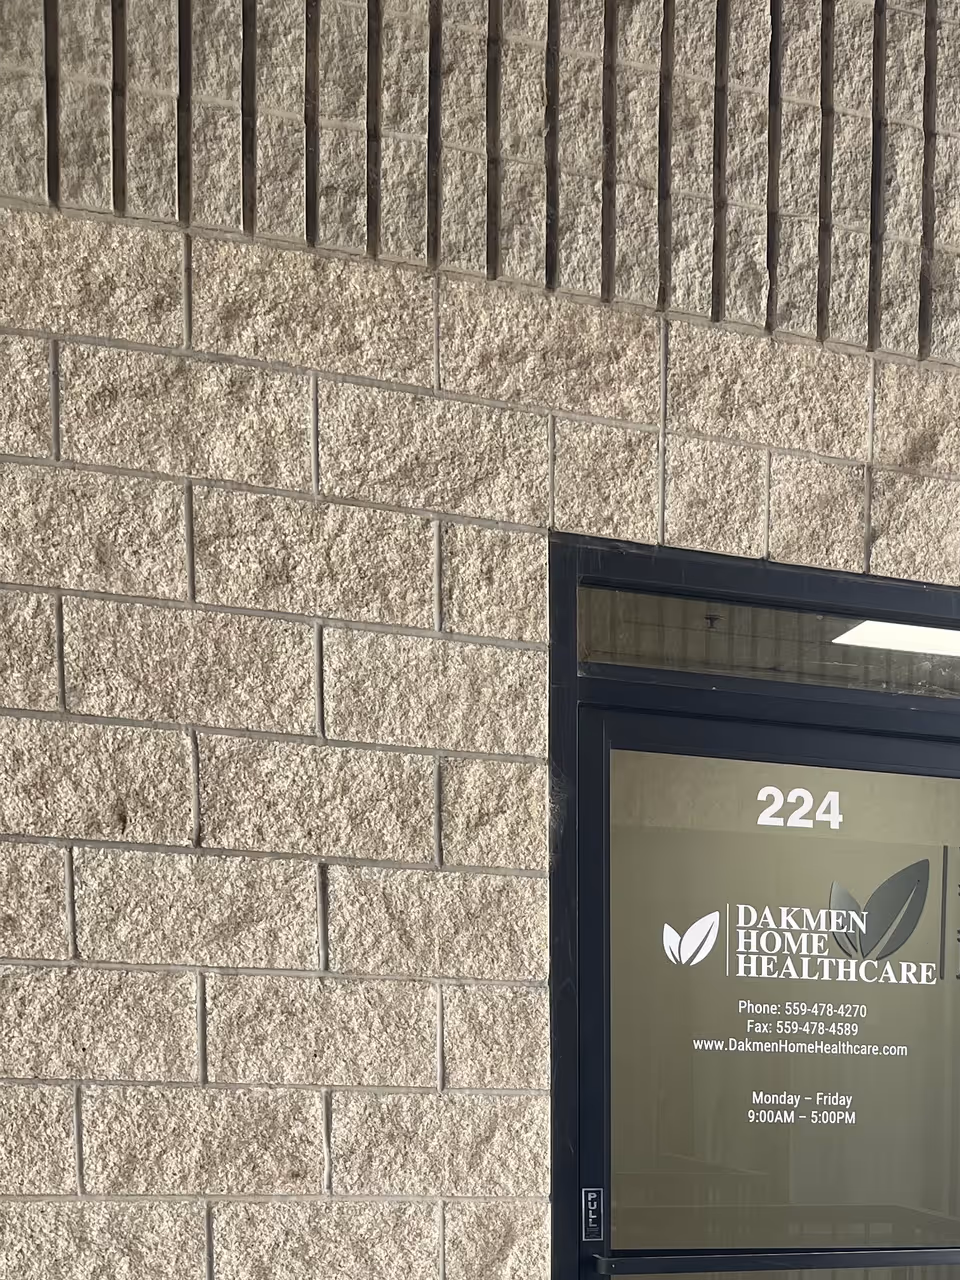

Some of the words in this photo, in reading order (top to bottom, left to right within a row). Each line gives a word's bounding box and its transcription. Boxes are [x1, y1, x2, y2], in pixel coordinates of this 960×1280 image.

[756, 785, 844, 830] 224
[736, 903, 869, 935] DAKMEN
[736, 929, 830, 957] HOME
[736, 953, 938, 986] HEALTHCARE
[738, 1000, 782, 1016] Phone:
[784, 1001, 868, 1018] 559-478-4270
[746, 1020, 773, 1034] Fax:
[775, 1020, 859, 1036] 559-478-4589
[692, 1037, 909, 1056] www.DakmenHomeHealthcare.com
[752, 1090, 801, 1108] Monday
[816, 1091, 853, 1109] Friday
[747, 1109, 796, 1124] 9:00AM
[810, 1110, 857, 1125] 5:00PM
[587, 1192, 598, 1227] PULL
